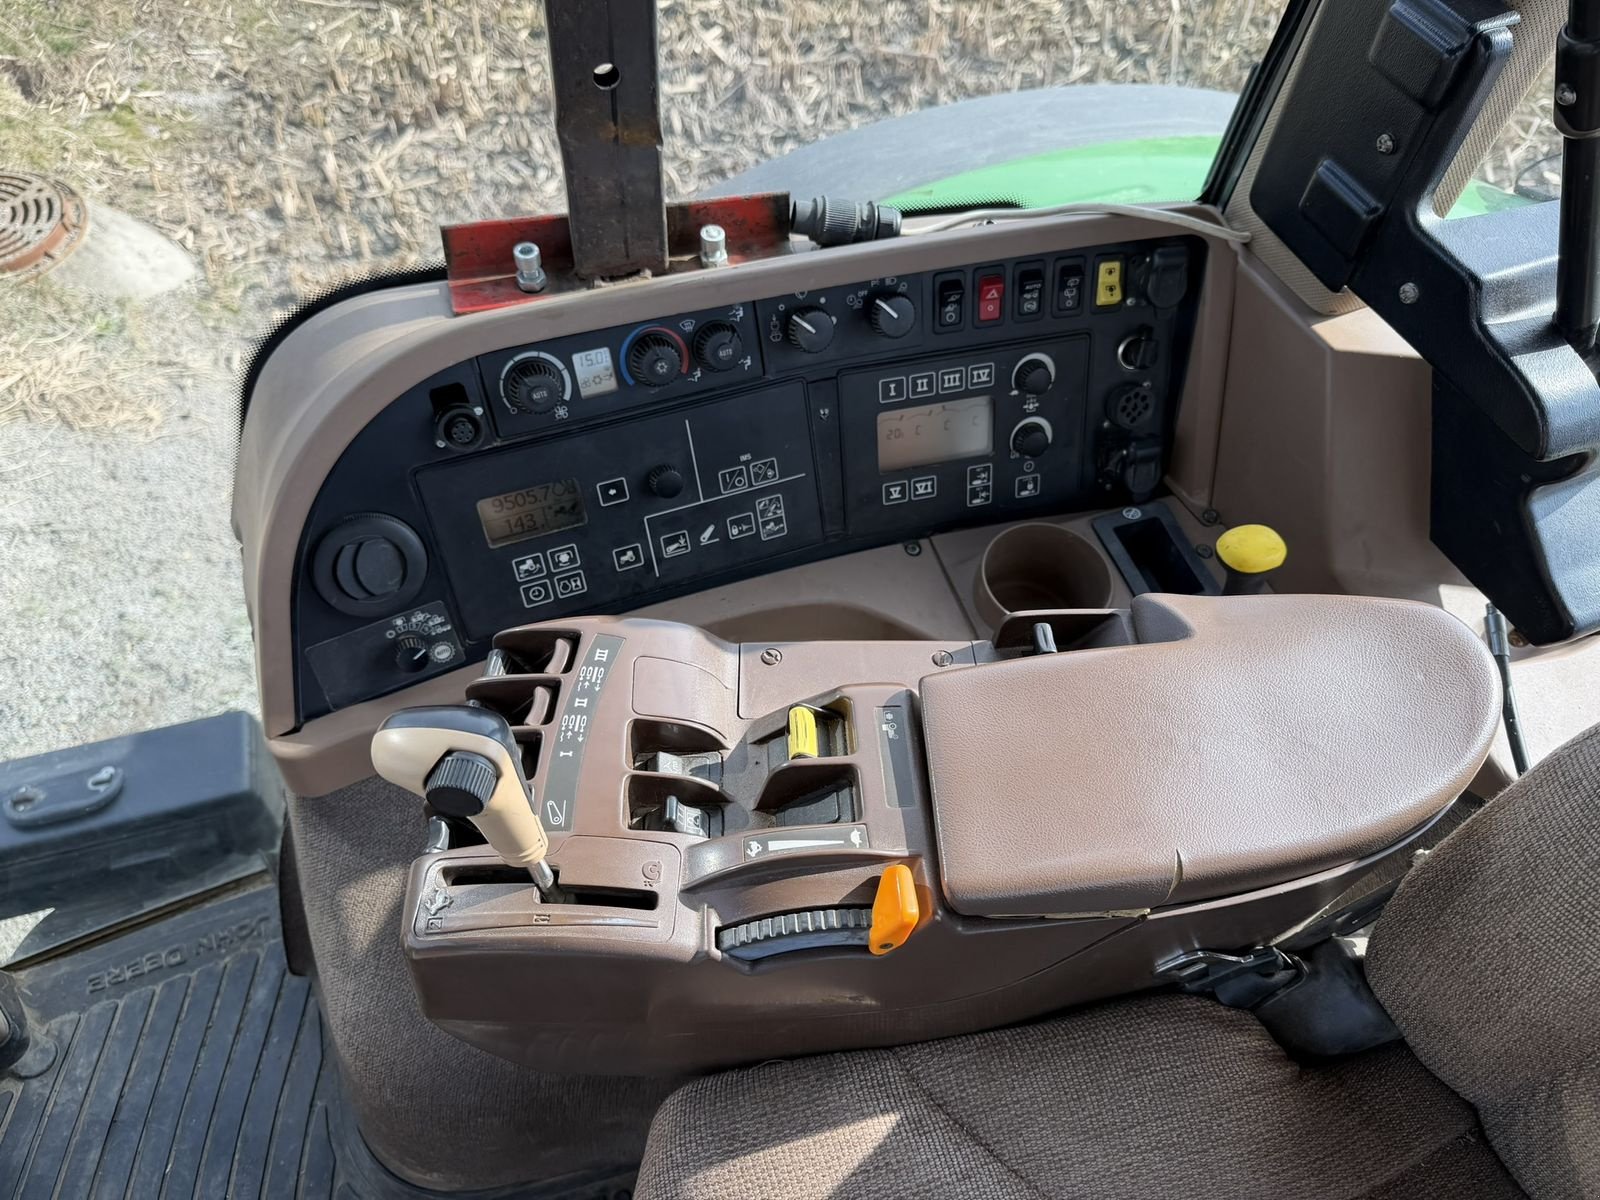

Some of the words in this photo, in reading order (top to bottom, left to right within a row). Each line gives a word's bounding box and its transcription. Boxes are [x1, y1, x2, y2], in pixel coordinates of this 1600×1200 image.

[943, 373, 961, 388] III
[972, 369, 990, 383] IV
[889, 383, 897, 397] I
[916, 378, 929, 392] II
[532, 390, 548, 400] AUTO
[889, 487, 902, 499] V
[915, 481, 933, 495] VI
[594, 648, 609, 662] III
[574, 697, 588, 708] II
[86, 948, 188, 995] DEERE
